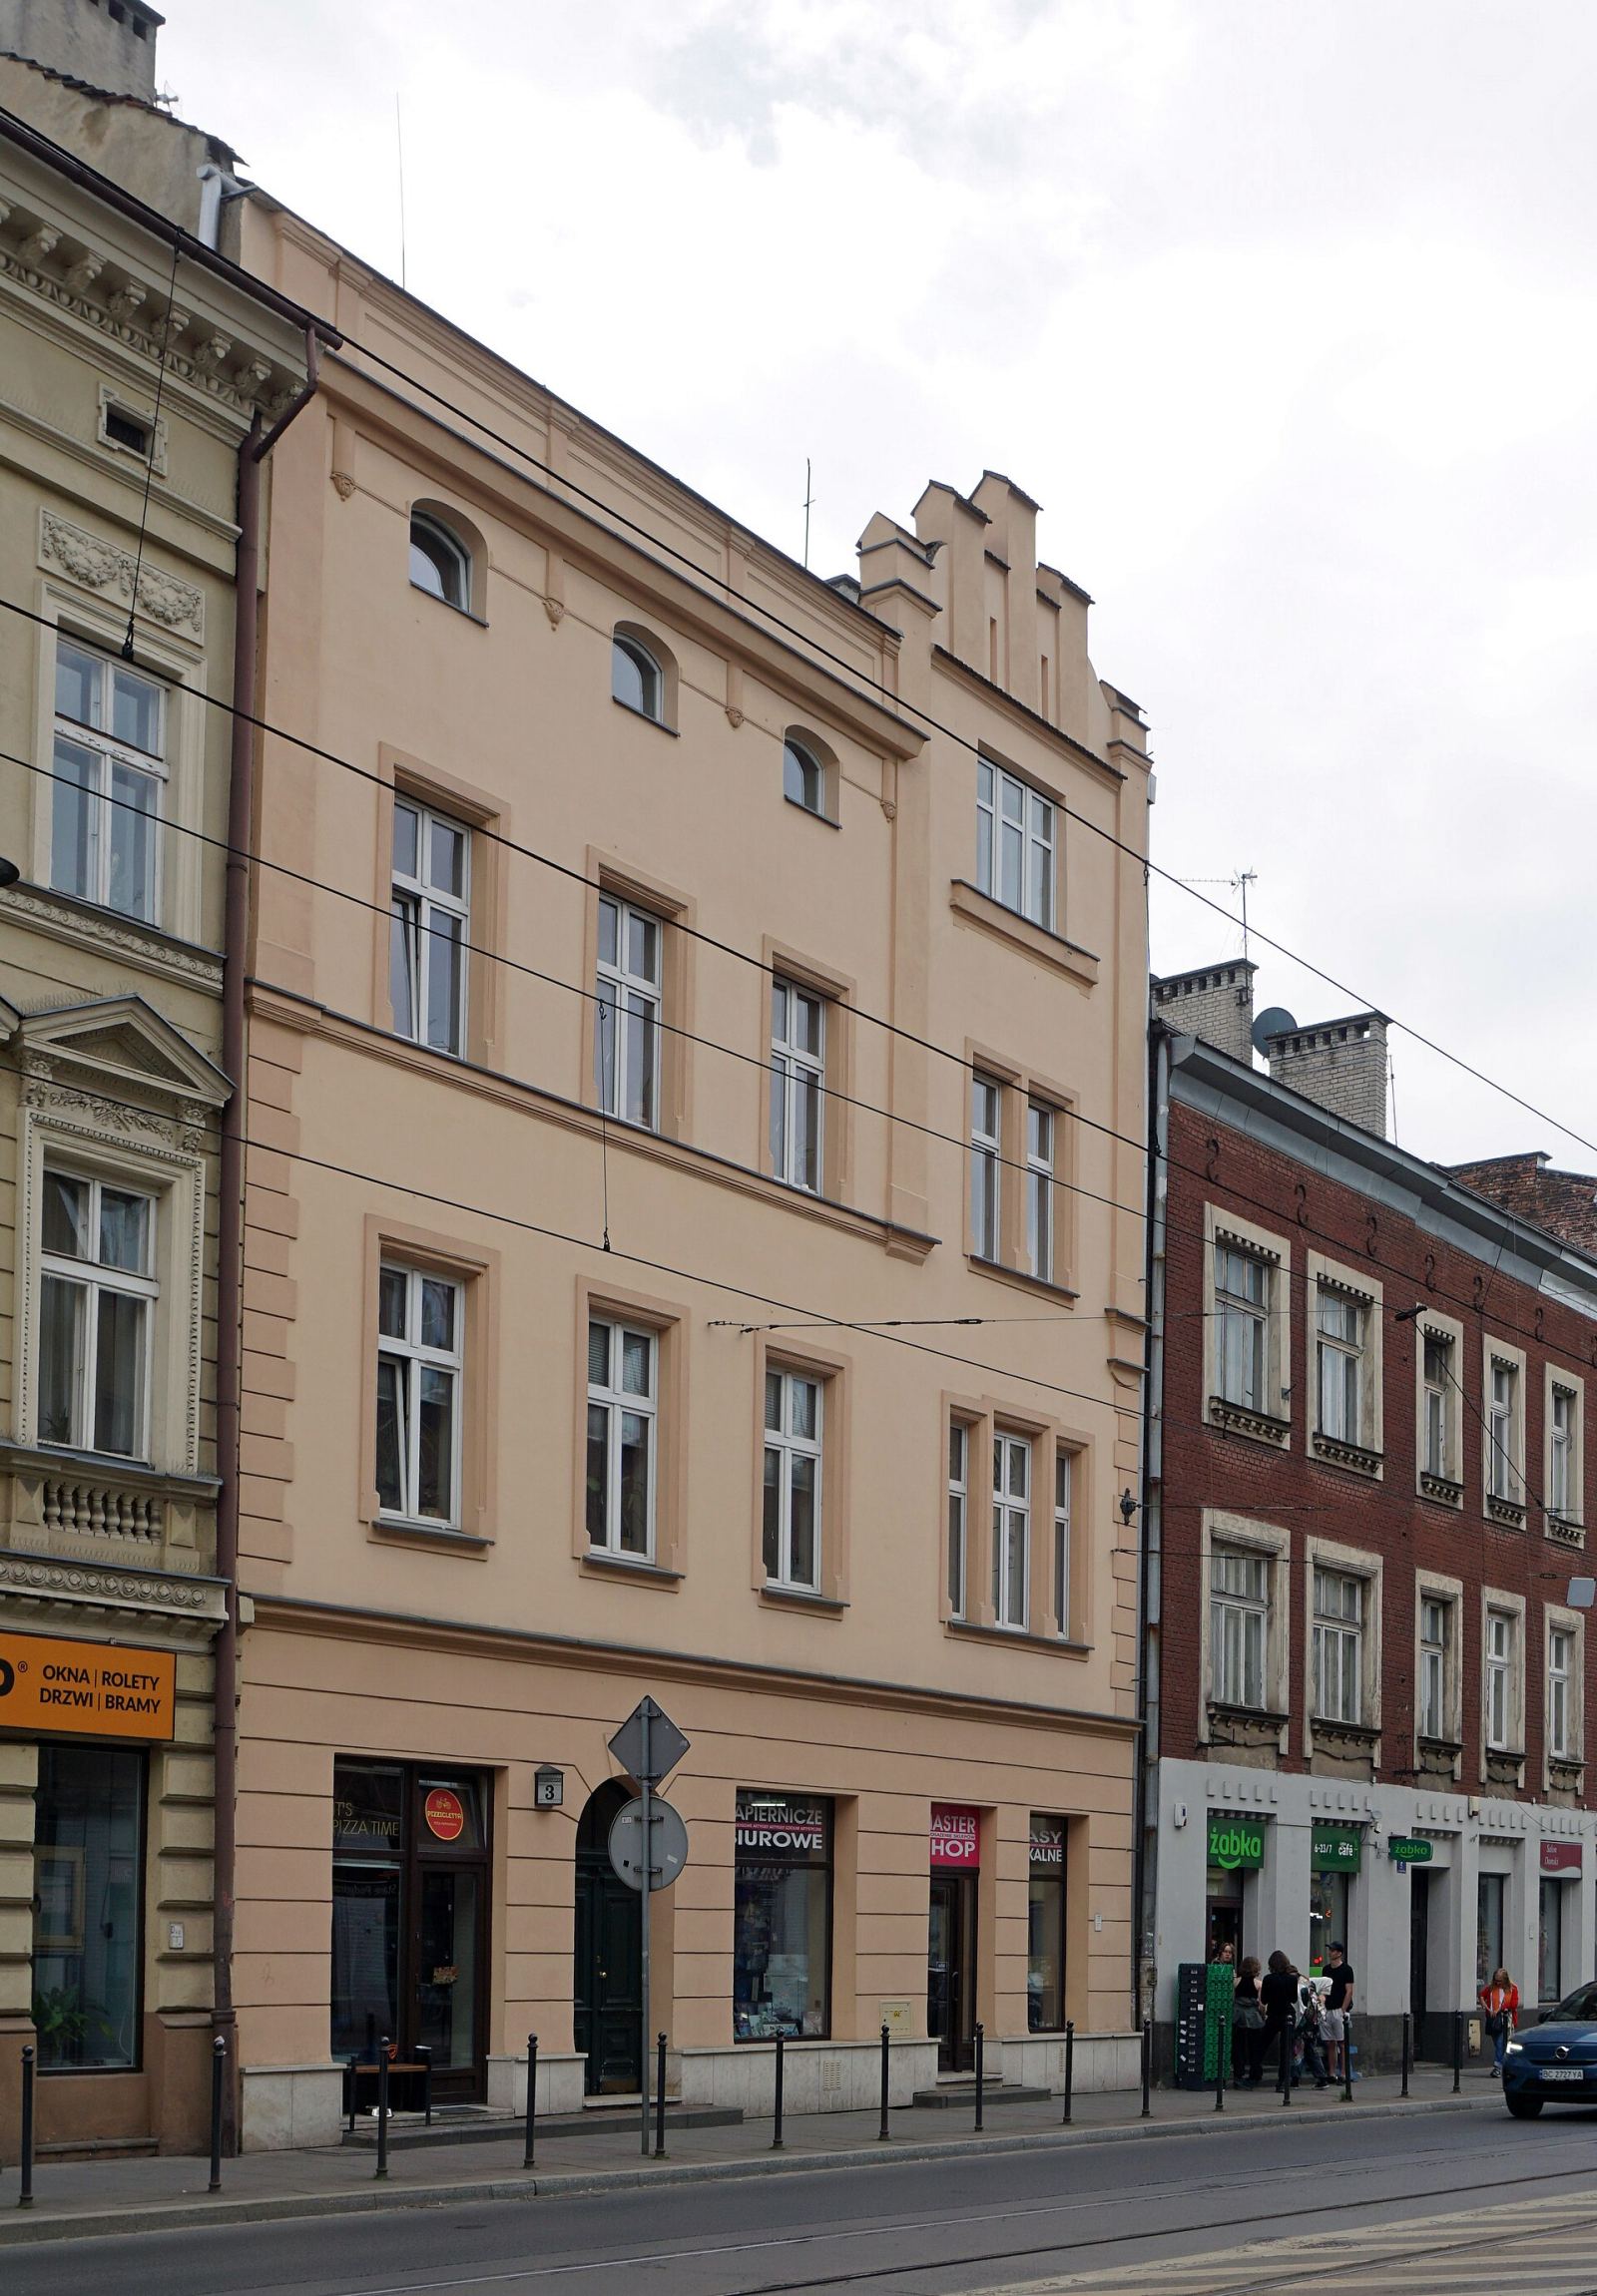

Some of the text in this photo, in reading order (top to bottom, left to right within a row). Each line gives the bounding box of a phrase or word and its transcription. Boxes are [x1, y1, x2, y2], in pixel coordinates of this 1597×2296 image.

[43, 1664, 90, 1684] OKNA
[102, 1670, 160, 1691] ROLETY
[39, 1687, 161, 1713] DRZWI BRAMY
[545, 1784, 555, 1801] 3
[334, 1801, 352, 1817] T'S
[735, 1805, 822, 1825] APIERNICZE
[333, 1819, 399, 1836] PIZZA TIME
[930, 1815, 975, 1833] ASTER
[735, 1829, 822, 1849] IUROWE
[1029, 1830, 1062, 1844] ASY
[1209, 1826, 1262, 1858] żabka
[931, 1839, 976, 1857] HOP
[1029, 1847, 1062, 1862] KALNE
[1394, 1843, 1428, 1855] żabka
